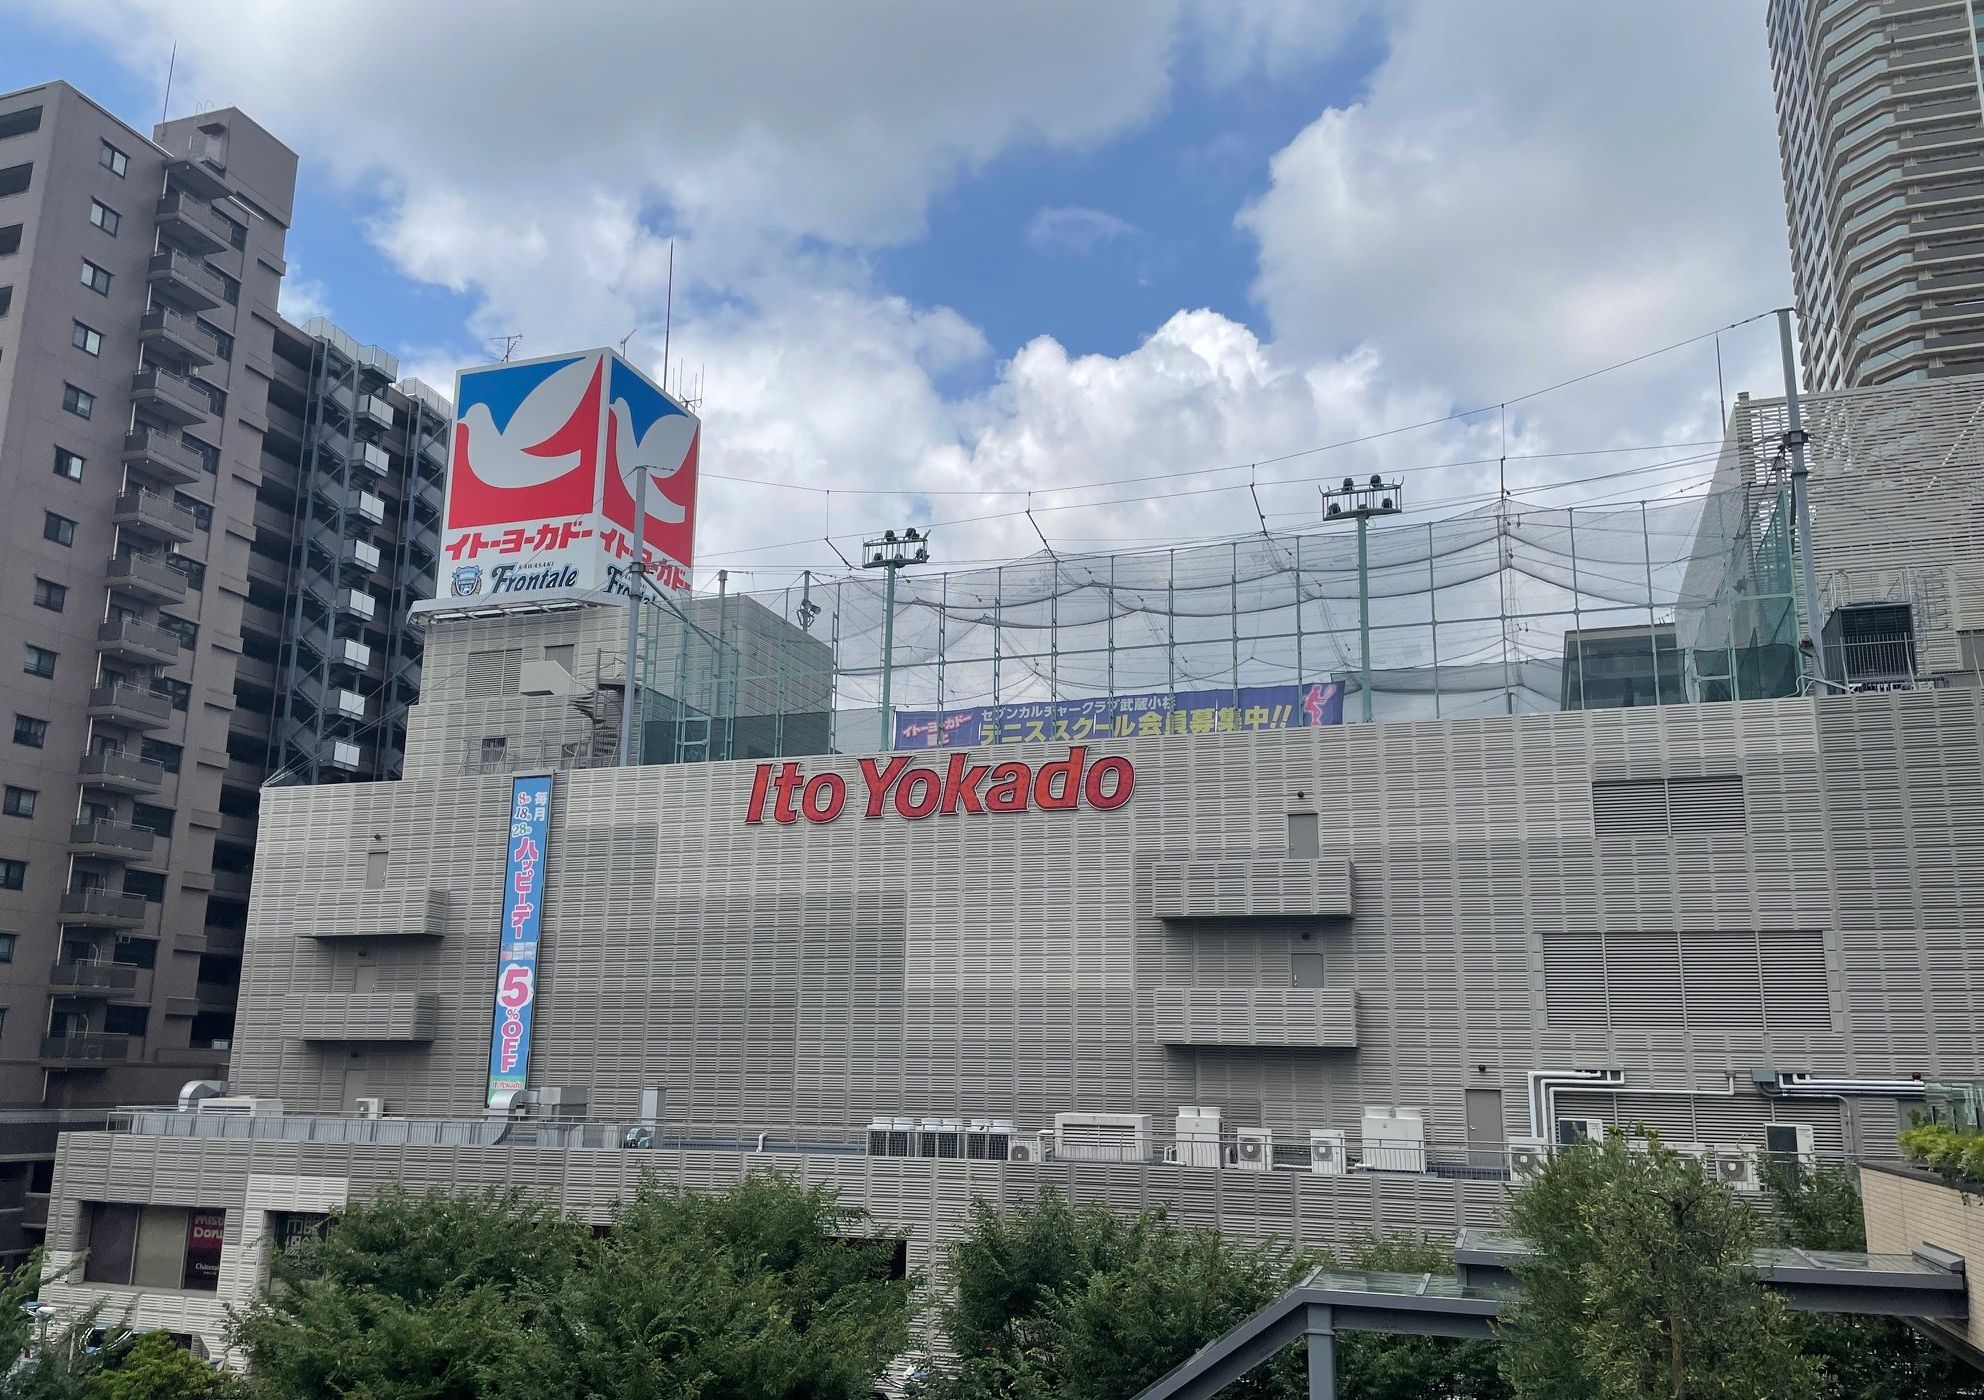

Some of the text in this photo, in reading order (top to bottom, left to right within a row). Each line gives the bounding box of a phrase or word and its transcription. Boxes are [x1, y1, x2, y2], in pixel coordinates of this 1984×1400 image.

[445, 521, 593, 560] イトーヨーカドー
[491, 563, 578, 593] Frontale
[744, 744, 1136, 825] Ito Yokado
[534, 791, 548, 822] 毎月
[512, 837, 538, 940] ハッピーデー
